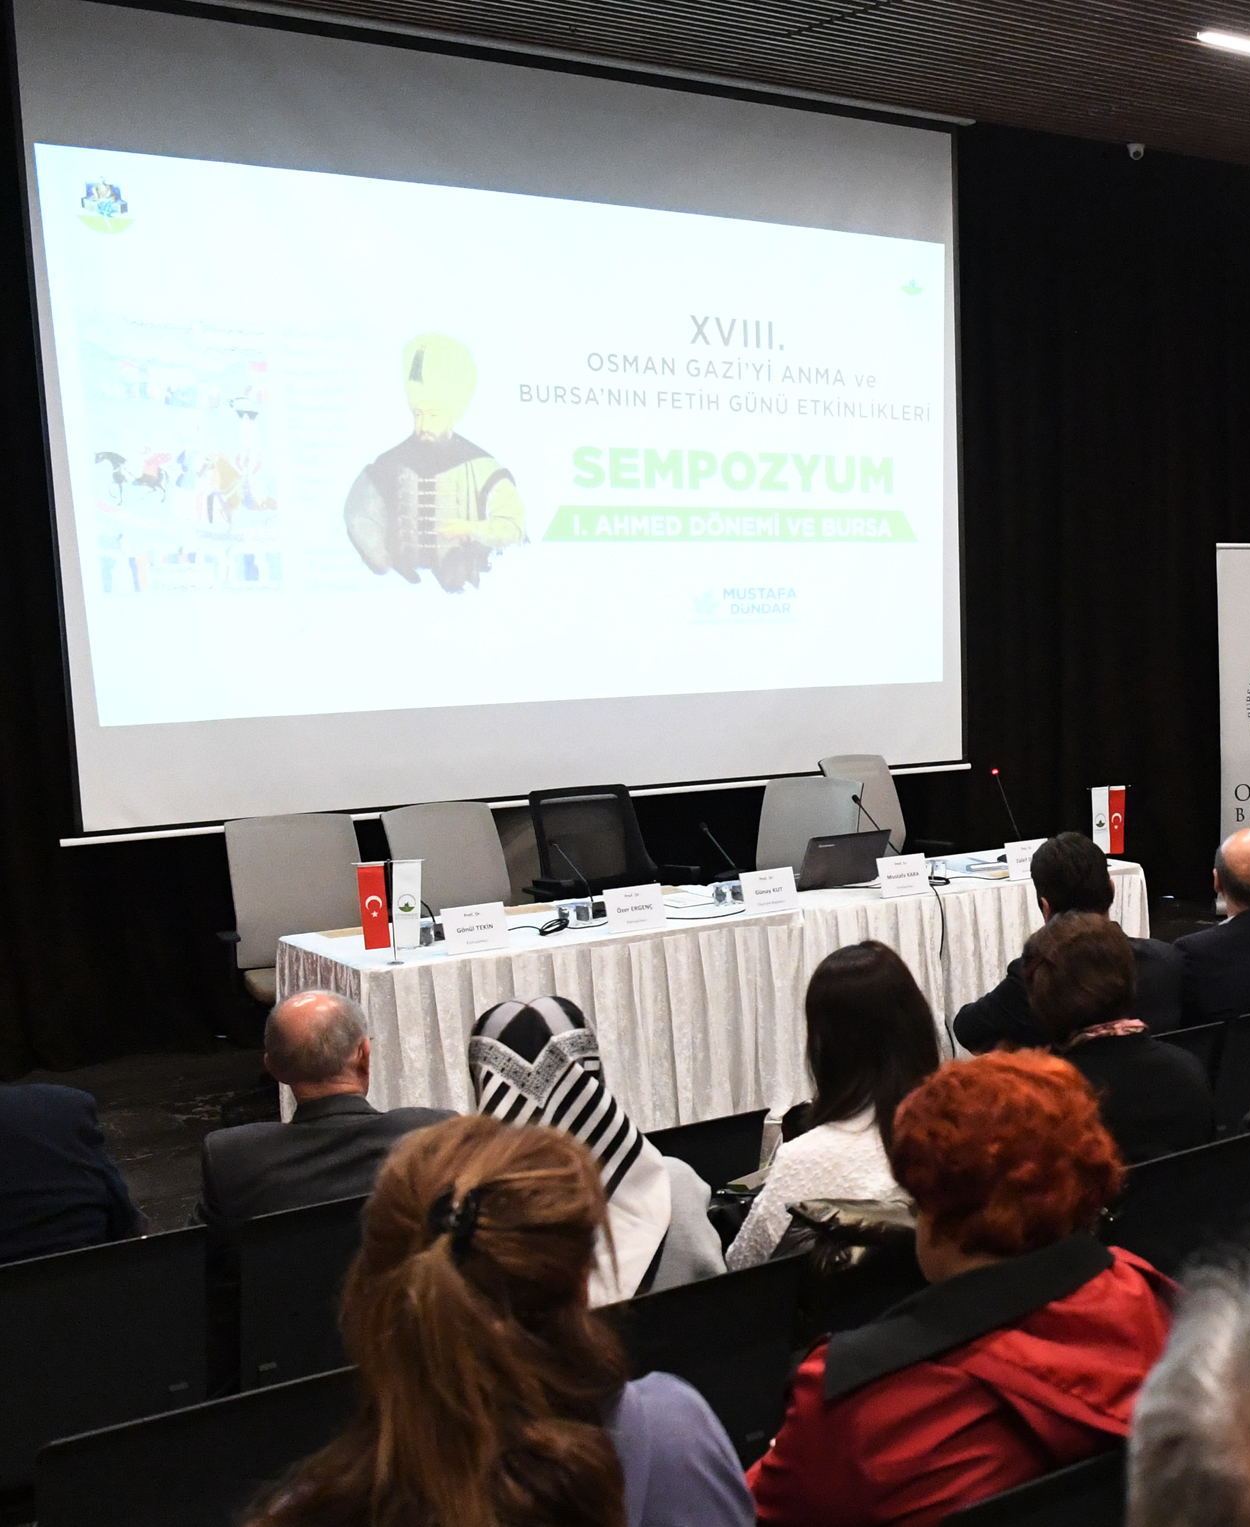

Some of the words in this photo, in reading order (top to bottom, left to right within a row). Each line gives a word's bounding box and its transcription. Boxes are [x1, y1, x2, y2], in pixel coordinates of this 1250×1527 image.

[690, 314, 784, 351] XVIII.
[587, 352, 675, 376] OSMAN
[686, 357, 771, 382] GAZİ'Yİ
[781, 365, 846, 387] ANMA
[854, 374, 877, 388] ve
[519, 384, 646, 408] BURSA'NIN
[657, 389, 720, 411] FETİH
[729, 391, 788, 414] GÜNÜ
[797, 397, 930, 422] ETKİNLİKLERİ
[572, 445, 894, 494] SEMPOZYUM
[595, 515, 683, 536] AHMED
[689, 511, 780, 537] DÖNEMİ
[787, 517, 816, 537] VE
[822, 517, 893, 538] BURSA
[723, 587, 798, 600] MUSTAFA
[730, 602, 792, 614] DÜNDAR
[475, 923, 494, 931] TEKİN
